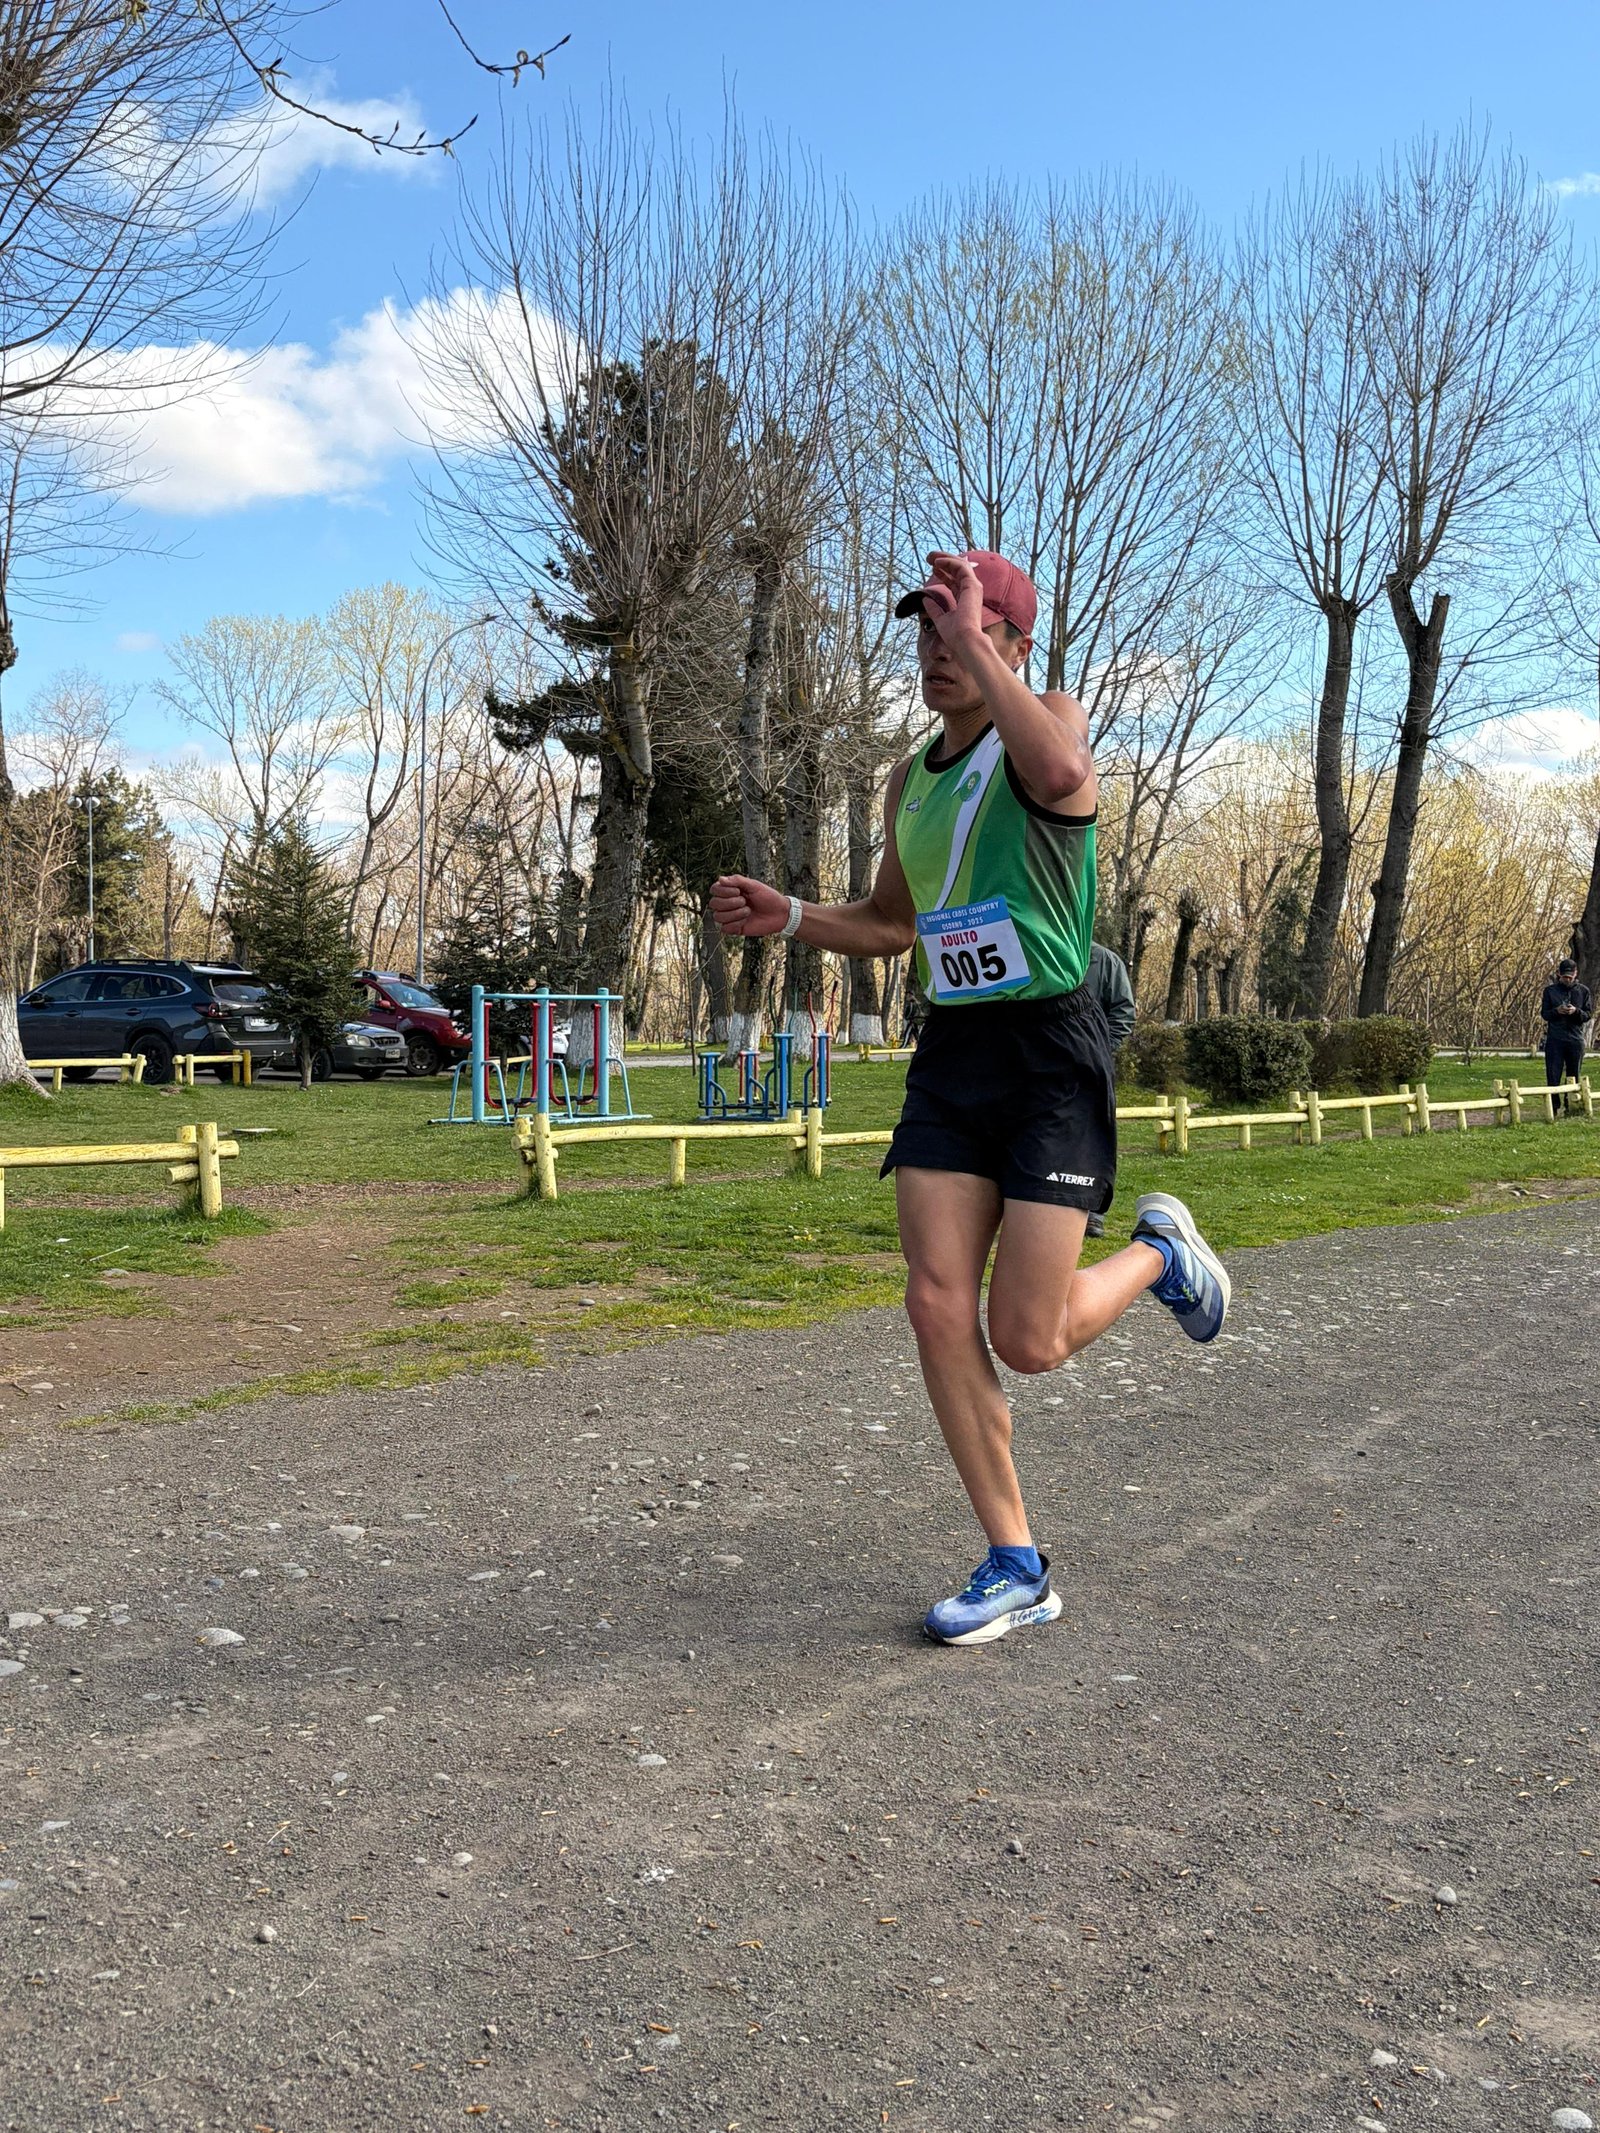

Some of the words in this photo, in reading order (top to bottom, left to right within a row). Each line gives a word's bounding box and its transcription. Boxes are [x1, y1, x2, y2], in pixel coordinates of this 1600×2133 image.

[925, 911, 951, 923] REGIONAL
[952, 909, 968, 919] CROSS
[968, 901, 1000, 915] COUNTRY
[967, 916, 984, 925] 2025
[940, 930, 978, 948] ADULTO
[940, 943, 1007, 988] 005
[1059, 1173, 1096, 1187] TERREX
